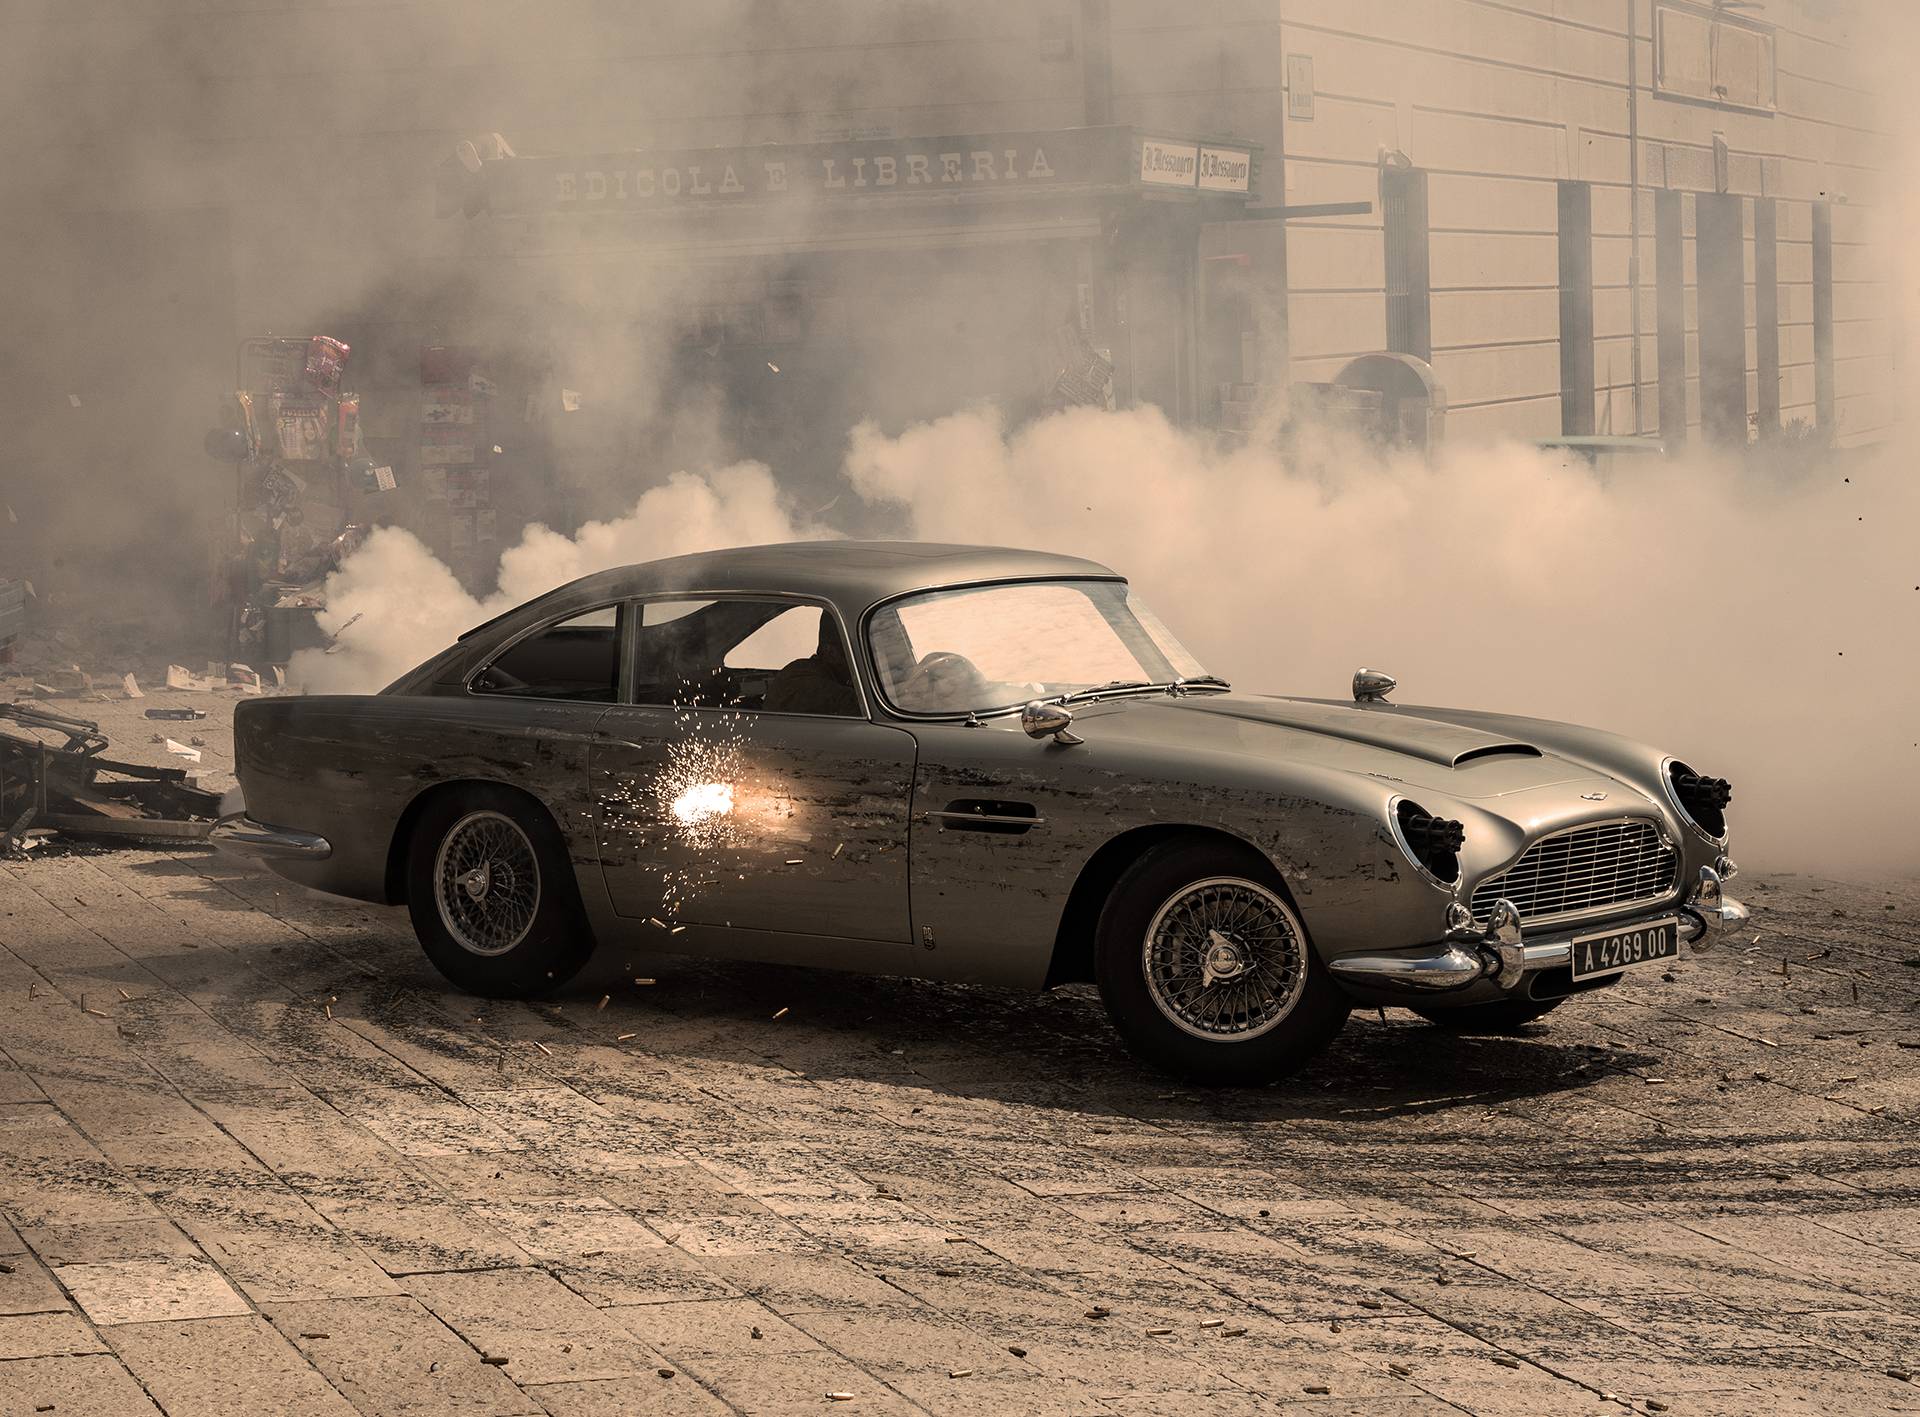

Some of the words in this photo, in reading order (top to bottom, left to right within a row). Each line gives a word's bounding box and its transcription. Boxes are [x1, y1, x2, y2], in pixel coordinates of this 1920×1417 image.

[555, 165, 745, 202] EDICOLA
[765, 161, 787, 191] E
[822, 148, 1056, 188] LIBRERIA
[1585, 943, 1594, 972] A
[1601, 933, 1641, 967] 4269
[1648, 928, 1666, 957] 00
